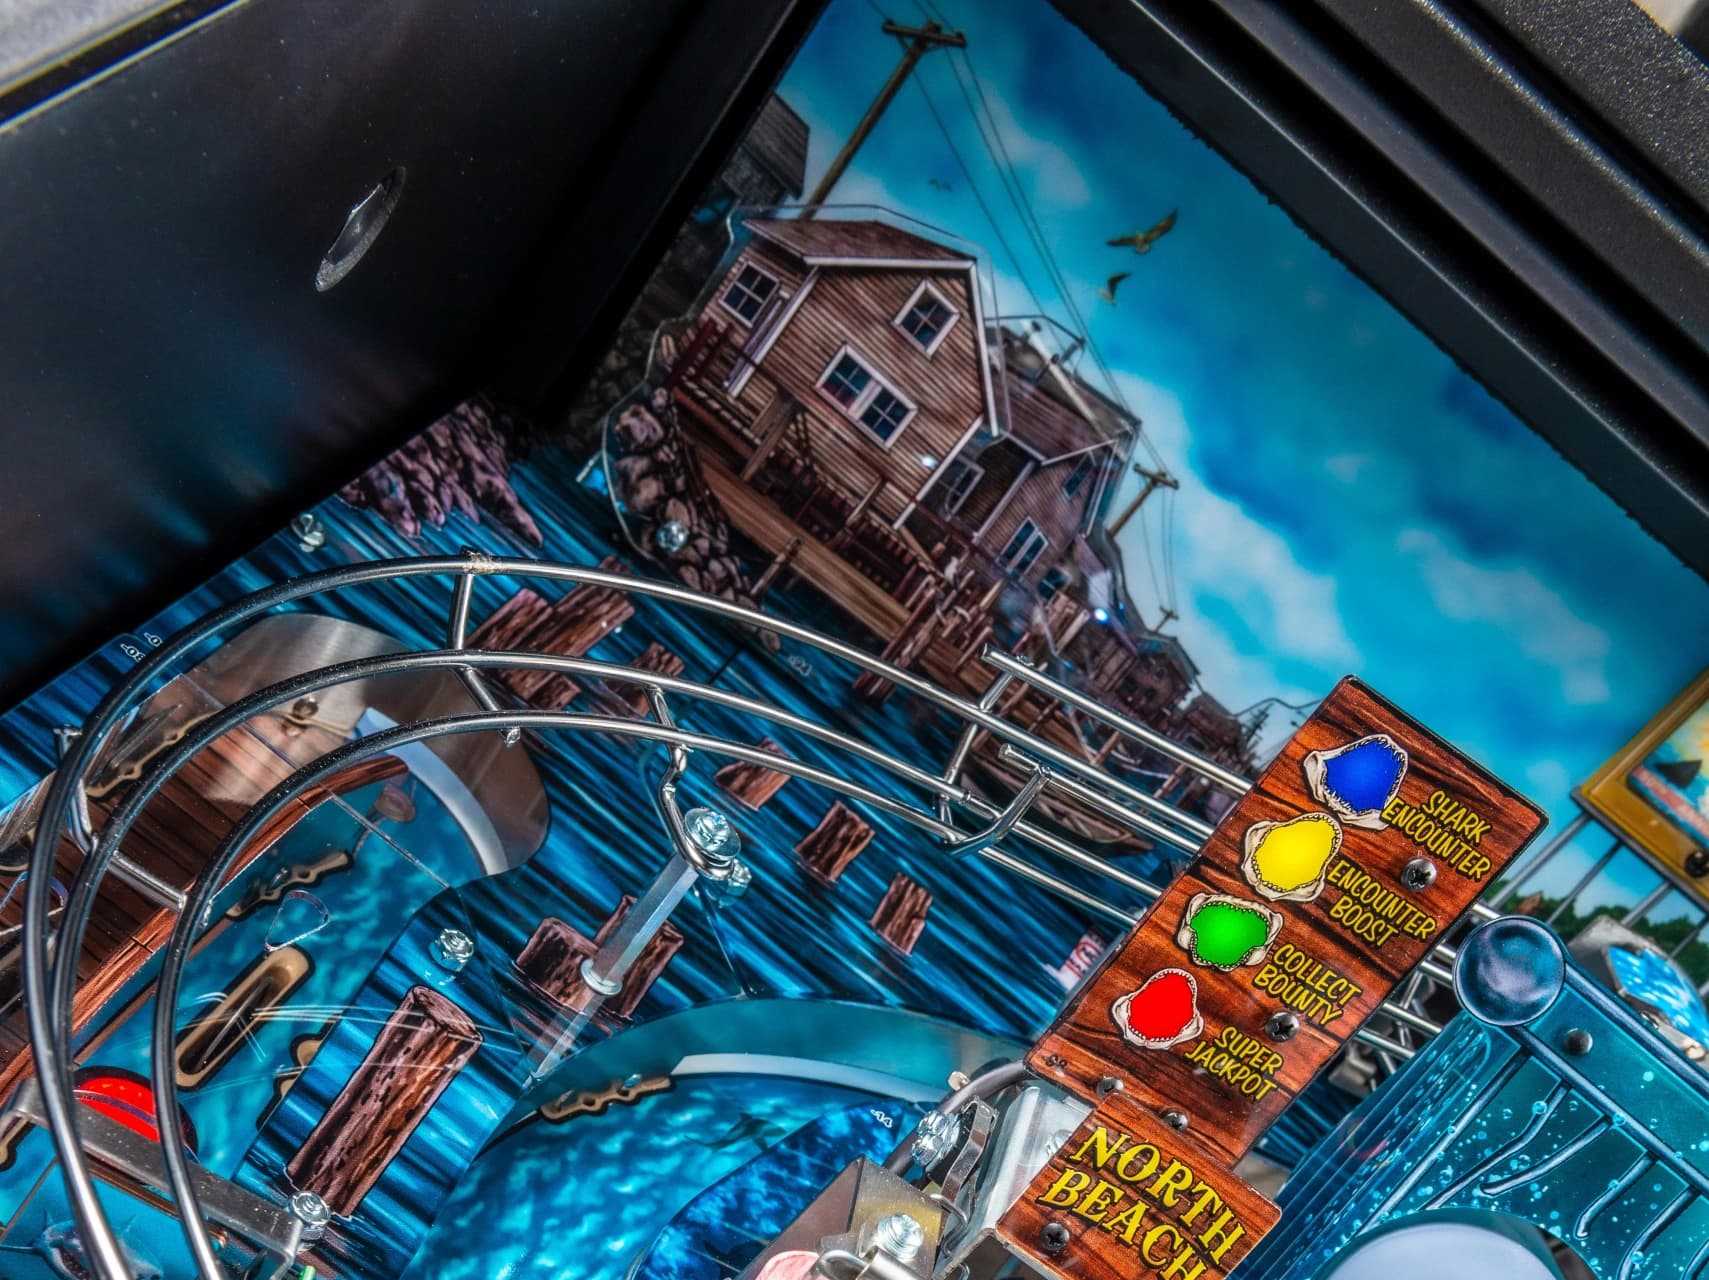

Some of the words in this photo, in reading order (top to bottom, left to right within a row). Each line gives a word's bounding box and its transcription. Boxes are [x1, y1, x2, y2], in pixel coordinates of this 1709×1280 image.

[1381, 797, 1491, 880] ENCOUNTER
[1422, 790, 1491, 844] SHARK
[1327, 860, 1437, 940] ENCOUNTER
[1329, 895, 1399, 947] BOOST
[1253, 963, 1343, 1026] BOUNTY
[1273, 943, 1362, 1006] COLLECT
[1184, 1040, 1278, 1101] JACKPOT
[1214, 1026, 1283, 1075] SUPER
[1069, 1126, 1247, 1265] NORTH
